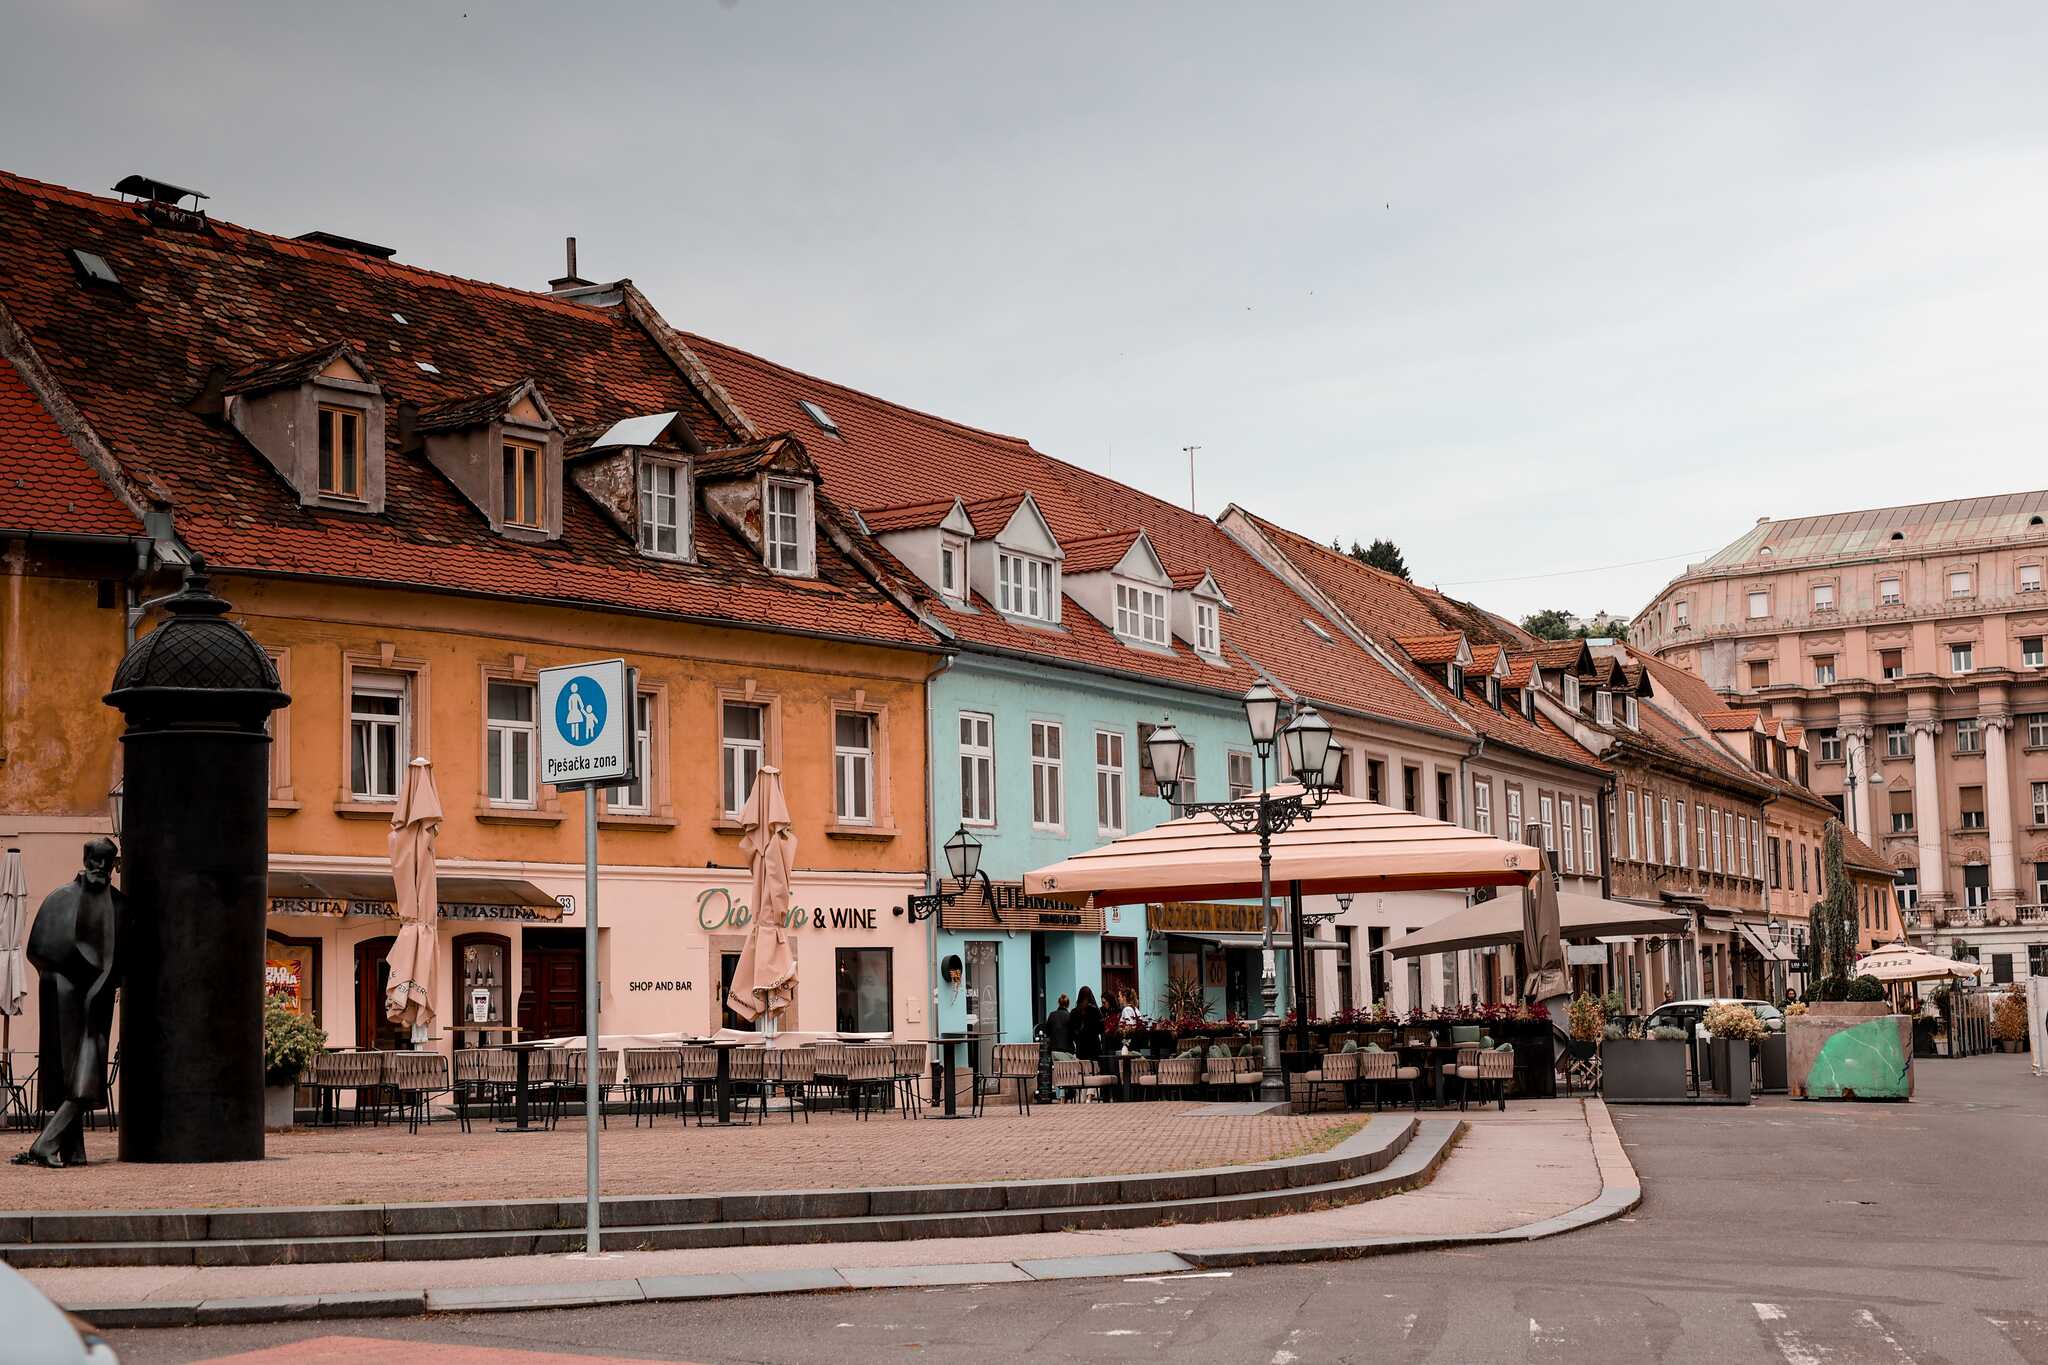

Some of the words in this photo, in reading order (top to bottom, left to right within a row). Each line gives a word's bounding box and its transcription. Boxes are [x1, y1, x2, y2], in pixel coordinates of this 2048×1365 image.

[548, 755, 590, 776] Pješačka
[593, 755, 617, 769] zona
[812, 907, 826, 930] &
[829, 908, 878, 930] WINE
[1861, 959, 1913, 970] Jana
[629, 981, 653, 991] SHOP
[655, 981, 674, 991] AND
[675, 981, 692, 991] BAR
